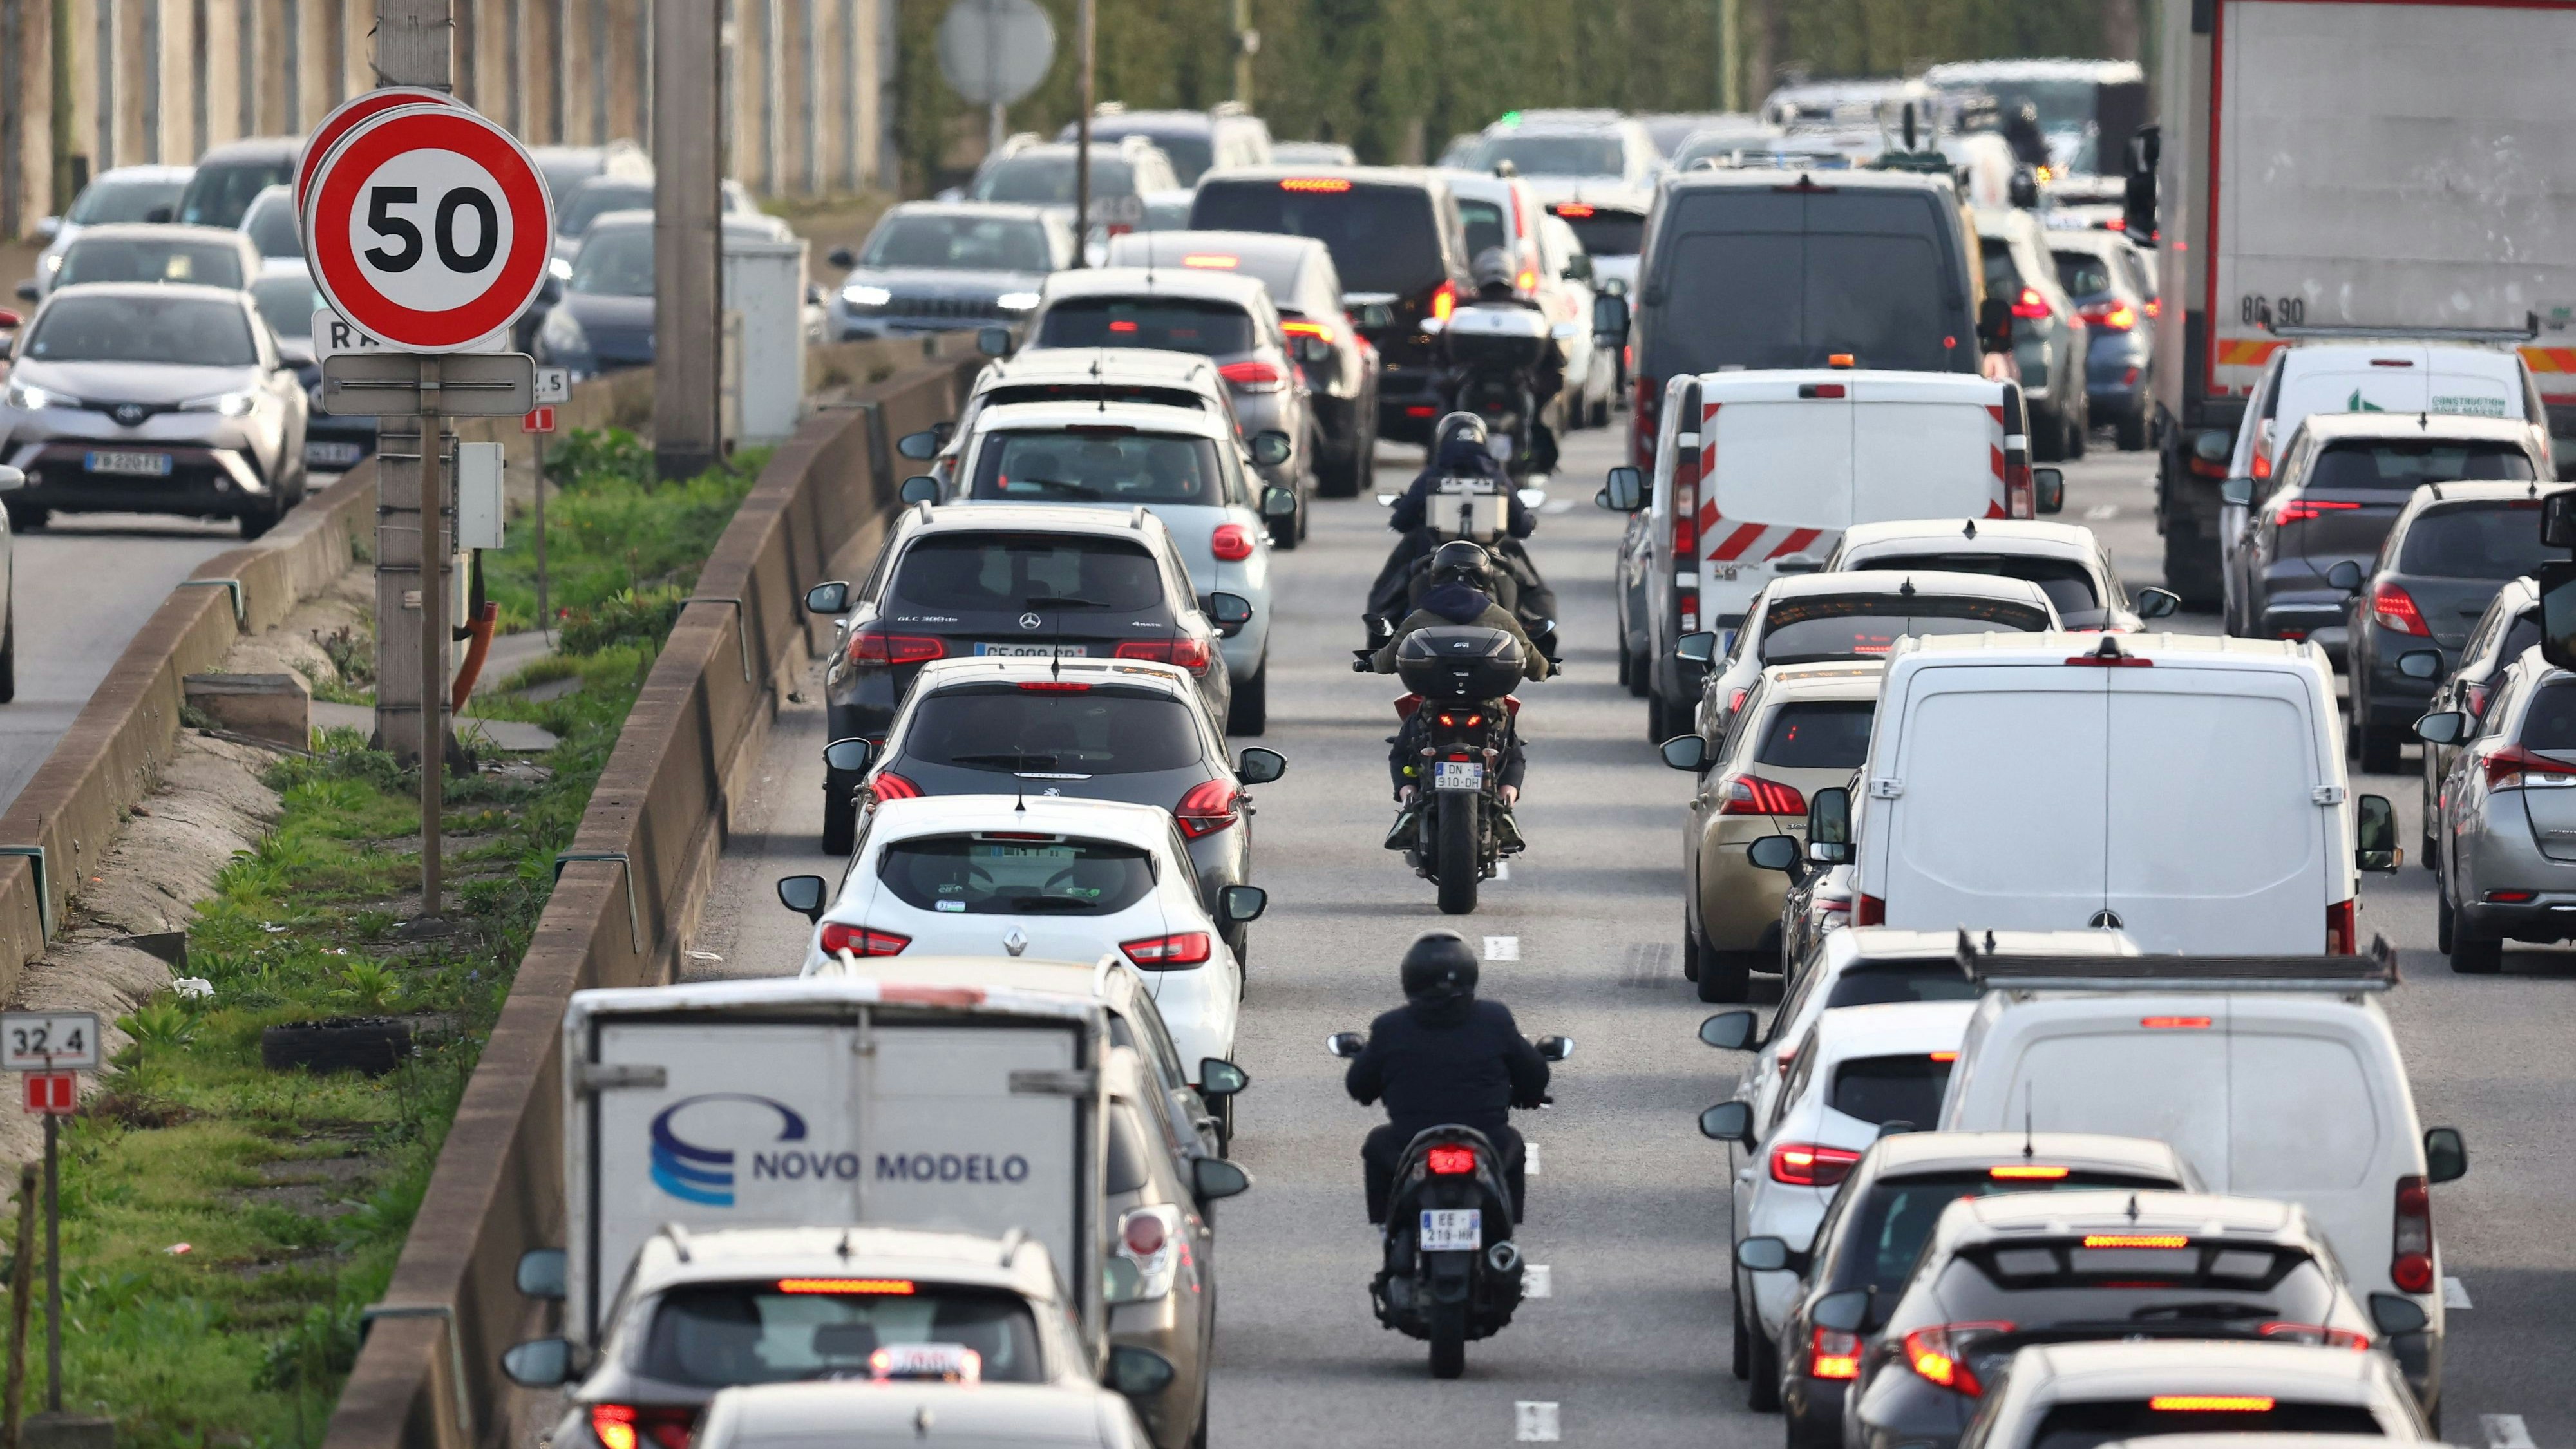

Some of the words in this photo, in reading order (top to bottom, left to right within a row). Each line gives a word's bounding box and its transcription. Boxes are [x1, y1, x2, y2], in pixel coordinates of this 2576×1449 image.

[364, 187, 498, 273] 50
[1438, 777, 1479, 788] 910-DH
[13, 1028, 84, 1056] 32.4
[753, 1151, 860, 1181] NOVO
[876, 1153, 1030, 1183] MODELO
